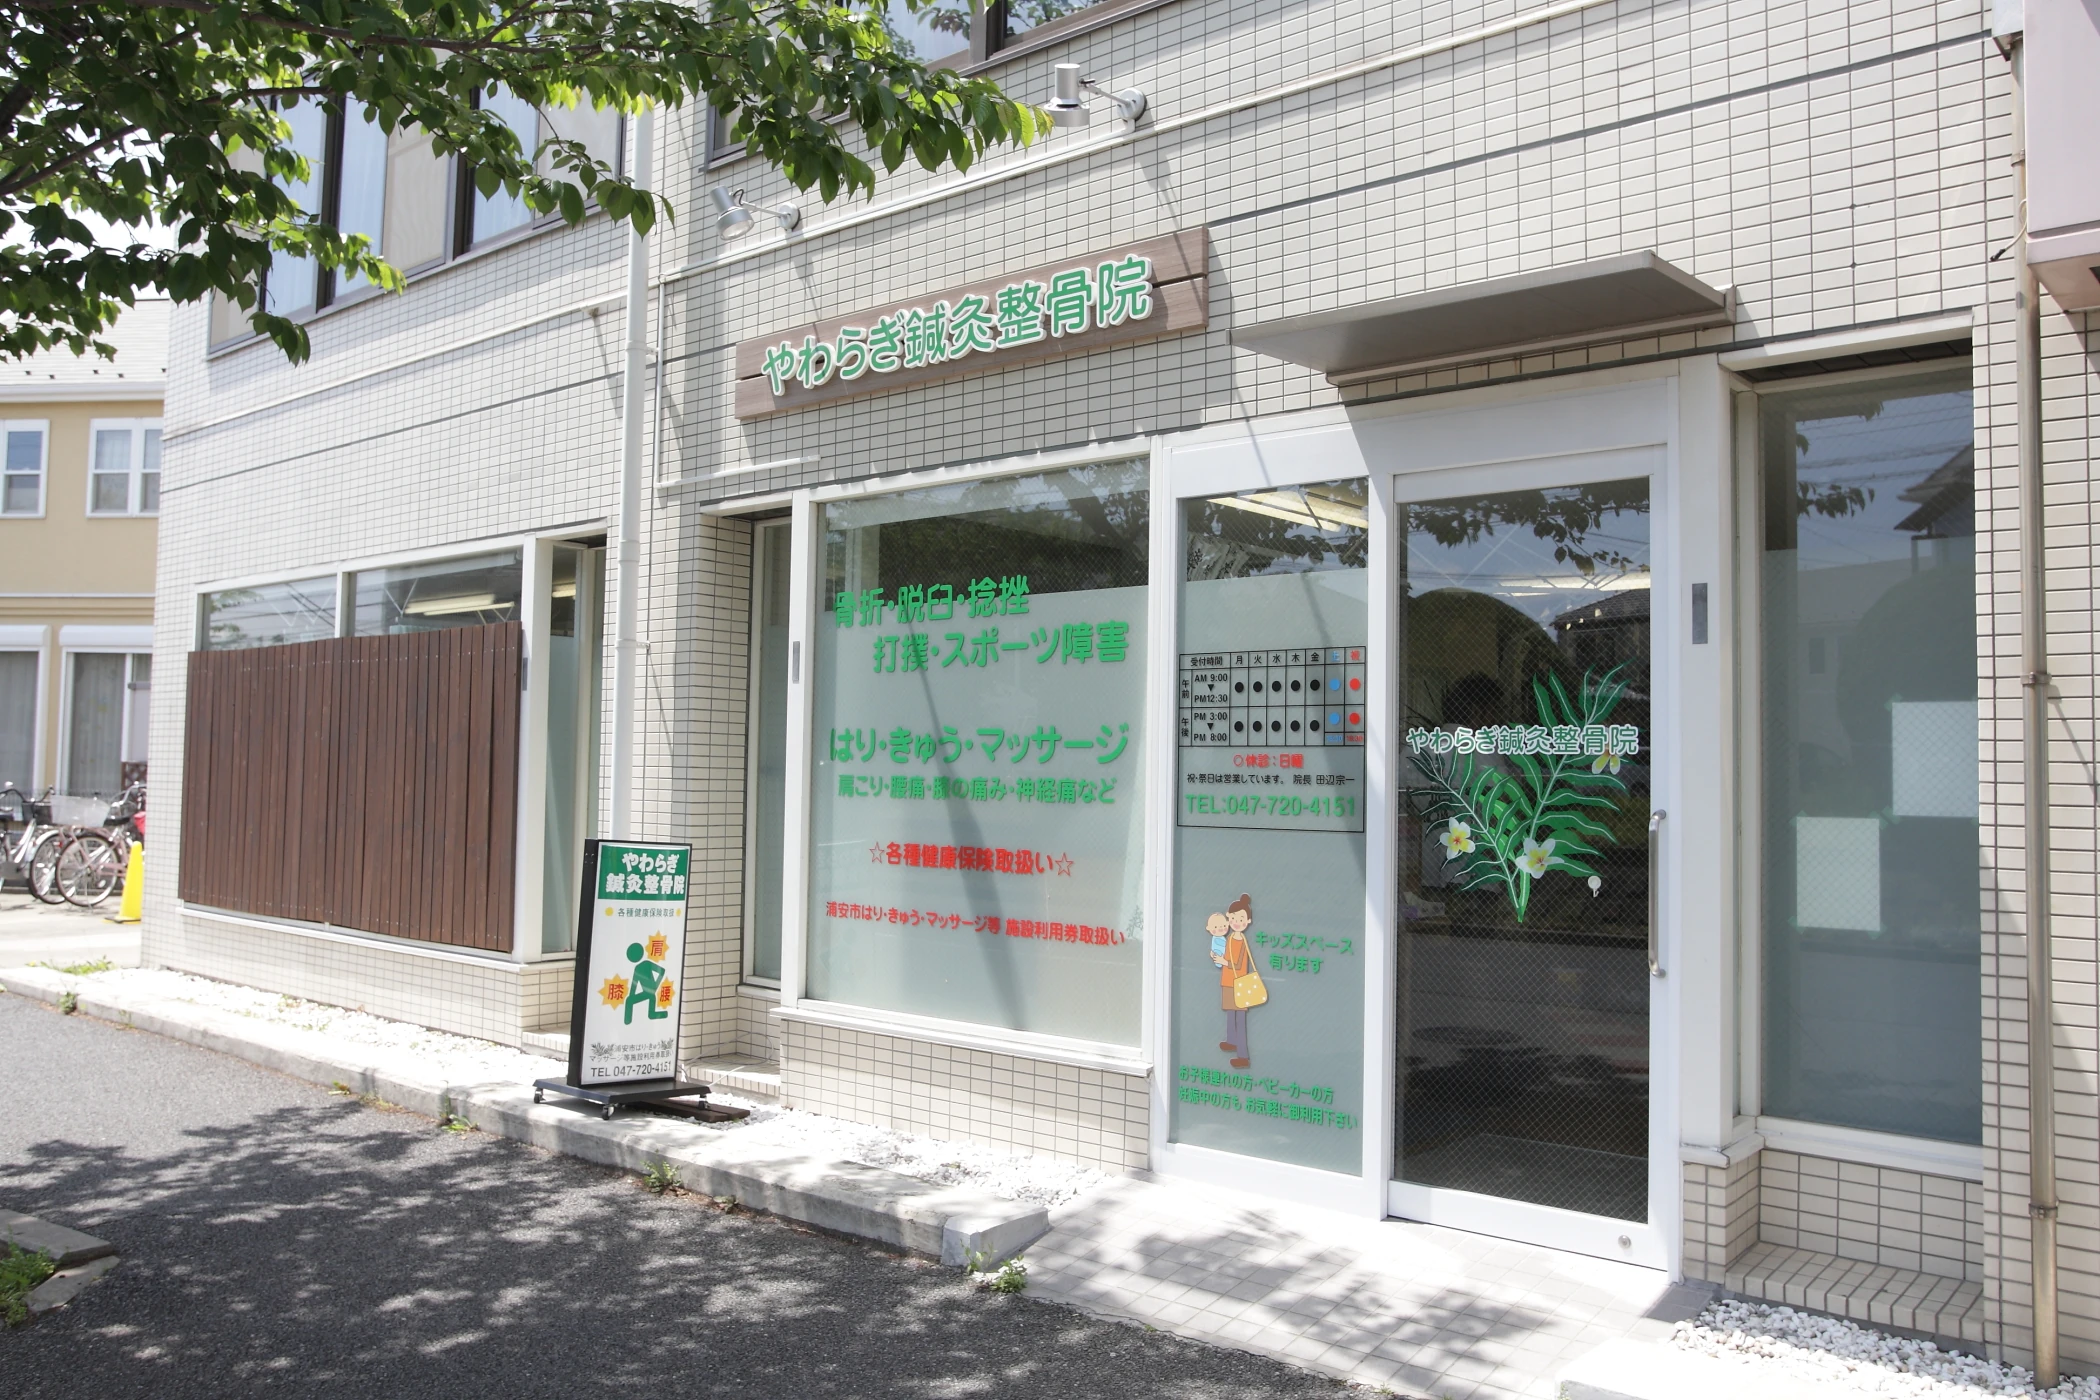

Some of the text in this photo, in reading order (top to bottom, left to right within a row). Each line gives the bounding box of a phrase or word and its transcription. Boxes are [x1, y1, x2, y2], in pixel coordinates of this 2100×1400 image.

[762, 254, 1152, 396] やわらぎ鍼灸整骨院
[833, 574, 1030, 628] 骨折・脱臼・捻挫
[873, 620, 1129, 673] 打撲・スポーツ障害
[1190, 656, 1223, 667] 受付時間
[1235, 655, 1243, 665] 月
[1253, 654, 1262, 664] 火
[1272, 653, 1281, 664] 水
[1291, 653, 1300, 663] 木
[1310, 652, 1320, 662] 金
[1194, 673, 1228, 682] AM 9:00
[1181, 679, 1190, 699] 午前
[1194, 694, 1228, 703] PM12:30
[1194, 712, 1228, 721] PM 3:00
[1181, 717, 1189, 737] 午後
[830, 722, 1129, 764] はり・きゅう・マッサージ
[1193, 733, 1227, 742] PM 8:00
[1406, 725, 1639, 754] やわらぎ鍼灸整骨院
[1293, 774, 1312, 785] 院長
[1185, 794, 1356, 817] TEL:047-720-4151
[622, 852, 679, 875] やわらぎ
[605, 872, 685, 895] 鍼灸整骨院
[650, 939, 665, 957] 肩
[1255, 931, 1354, 955] キッズスペース
[1269, 954, 1323, 974] 有ります
[607, 983, 625, 1001] 膝
[659, 985, 671, 1003] 腰
[591, 1060, 672, 1077] TEL 047-720-4151
